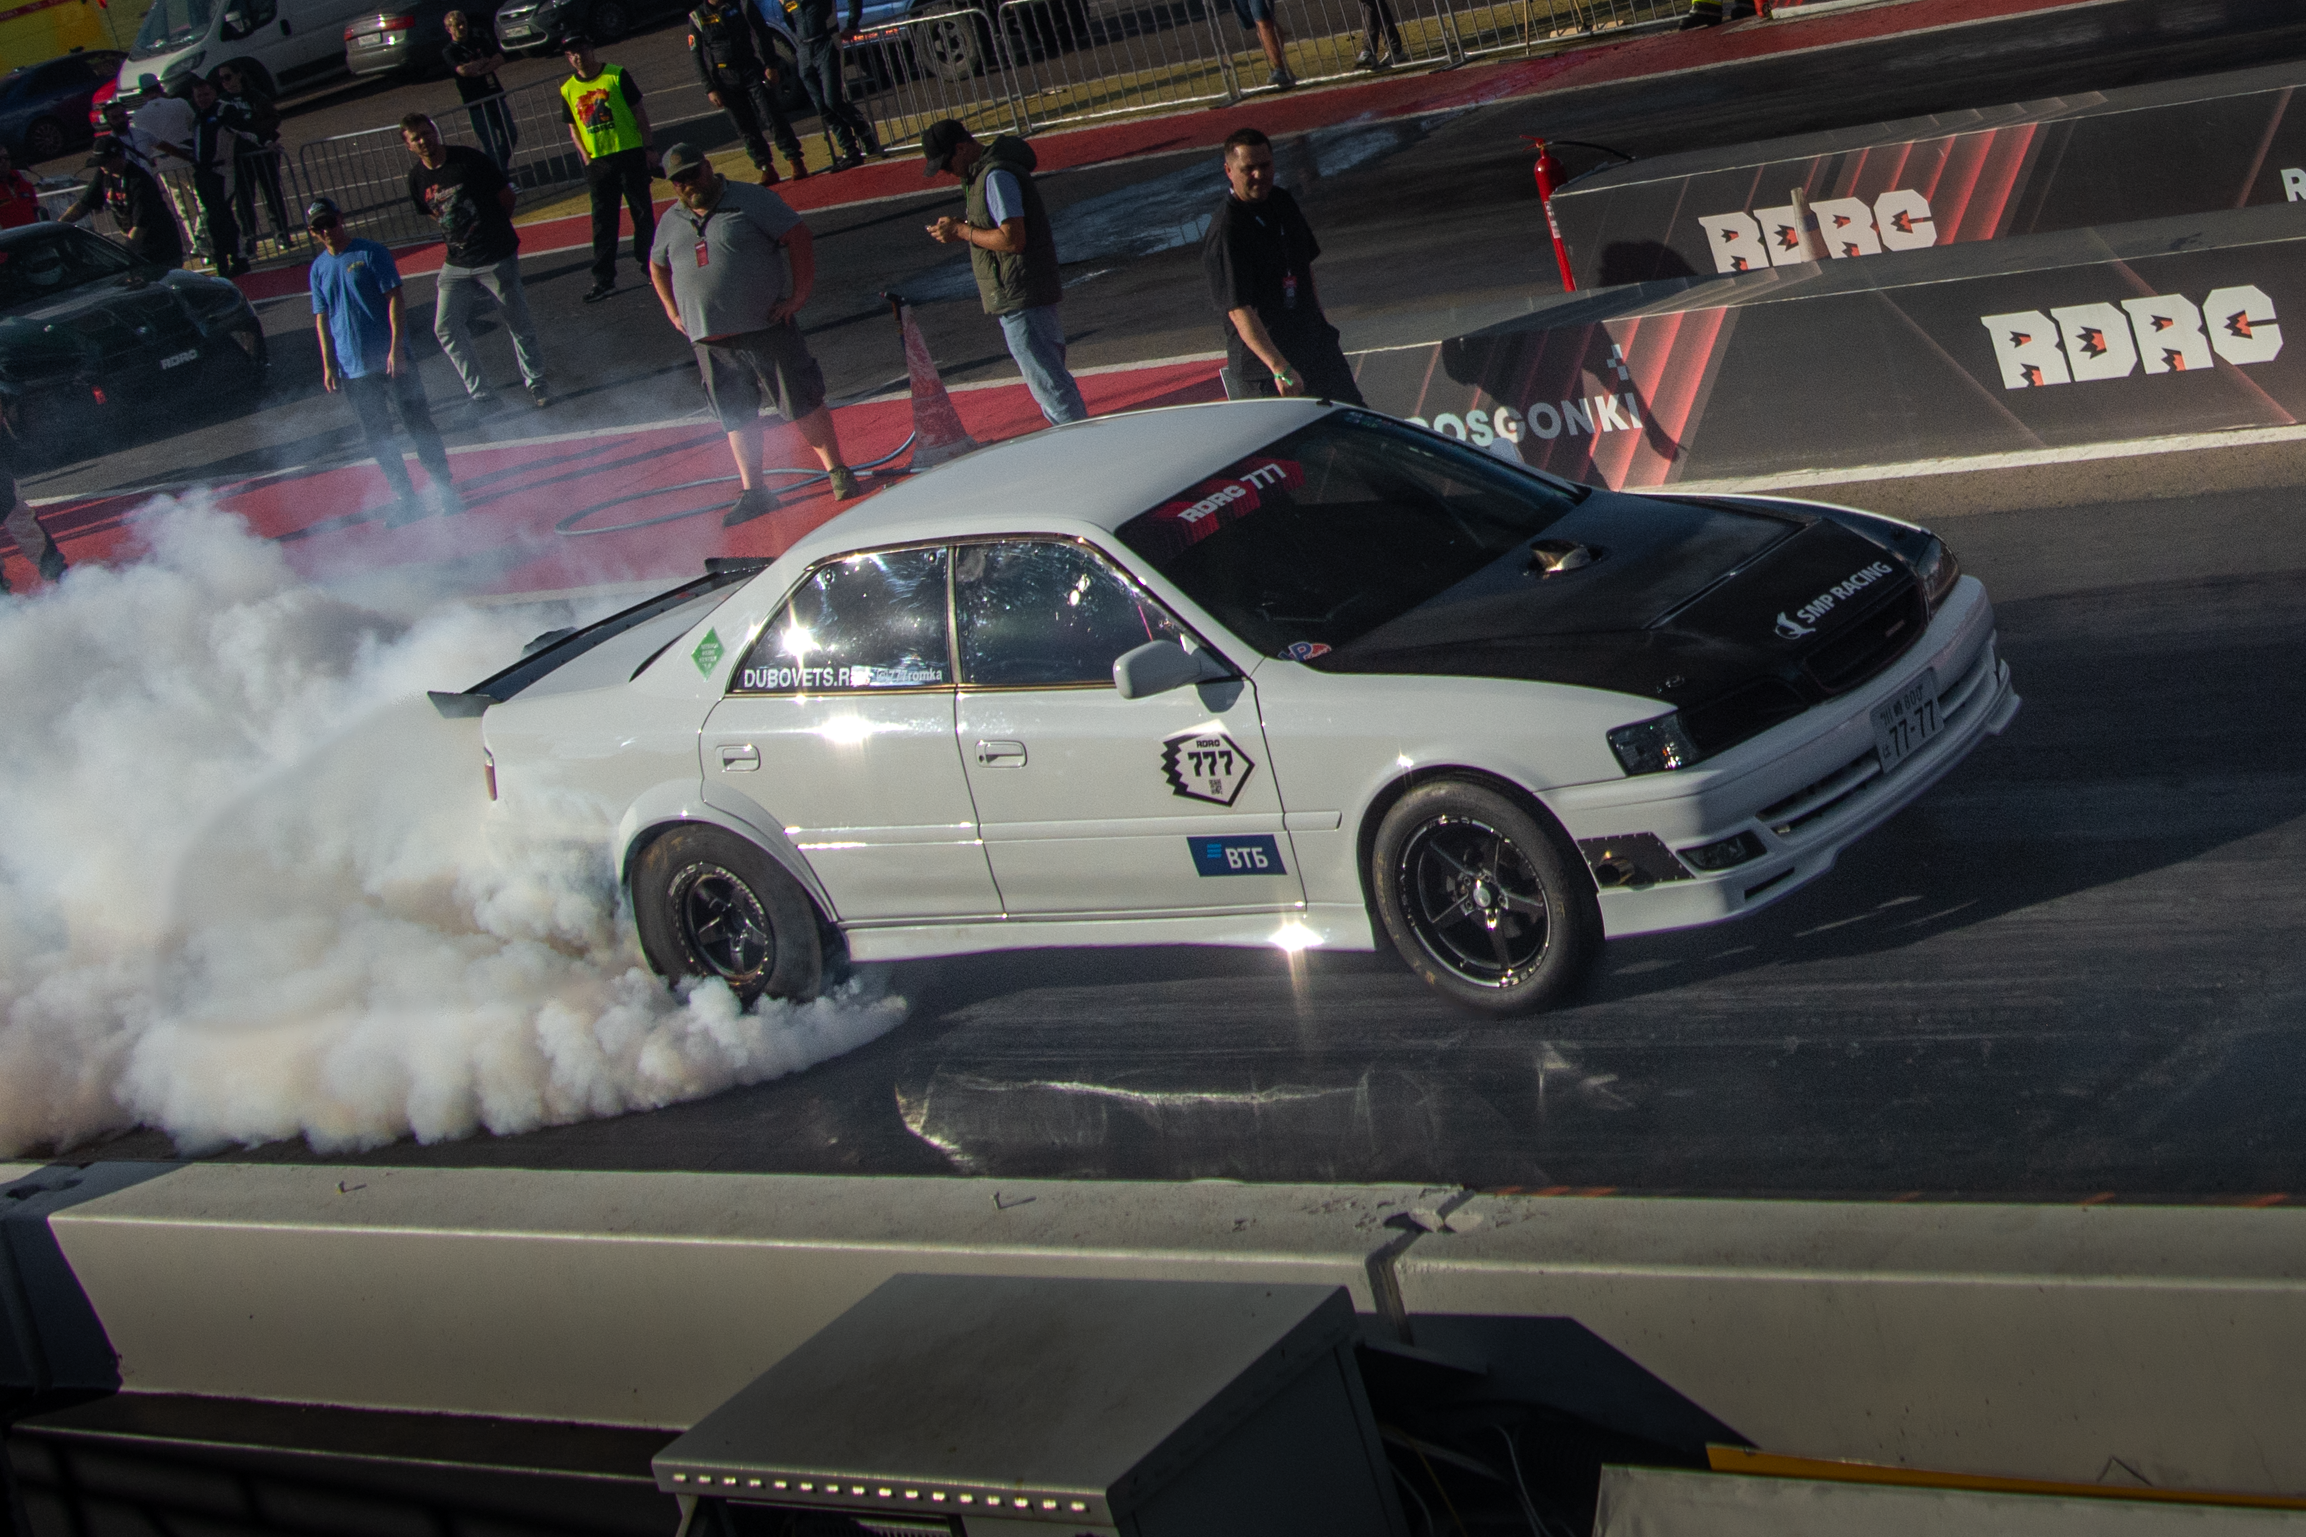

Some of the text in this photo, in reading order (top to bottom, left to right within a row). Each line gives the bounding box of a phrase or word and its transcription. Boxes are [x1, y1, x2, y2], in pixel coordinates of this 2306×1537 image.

[2280, 168, 2306, 203] R
[1698, 189, 1937, 274] RDRC
[161, 349, 198, 370] RDRC
[1981, 285, 2284, 389] RDRC
[1404, 392, 1643, 447] OSGONKI
[1177, 463, 1287, 523] RDRC 777
[1797, 561, 1893, 624] SMP RACING
[1889, 700, 1935, 757] 77-77
[1187, 750, 1232, 777] 777
[1225, 847, 1268, 868] ВТБ
